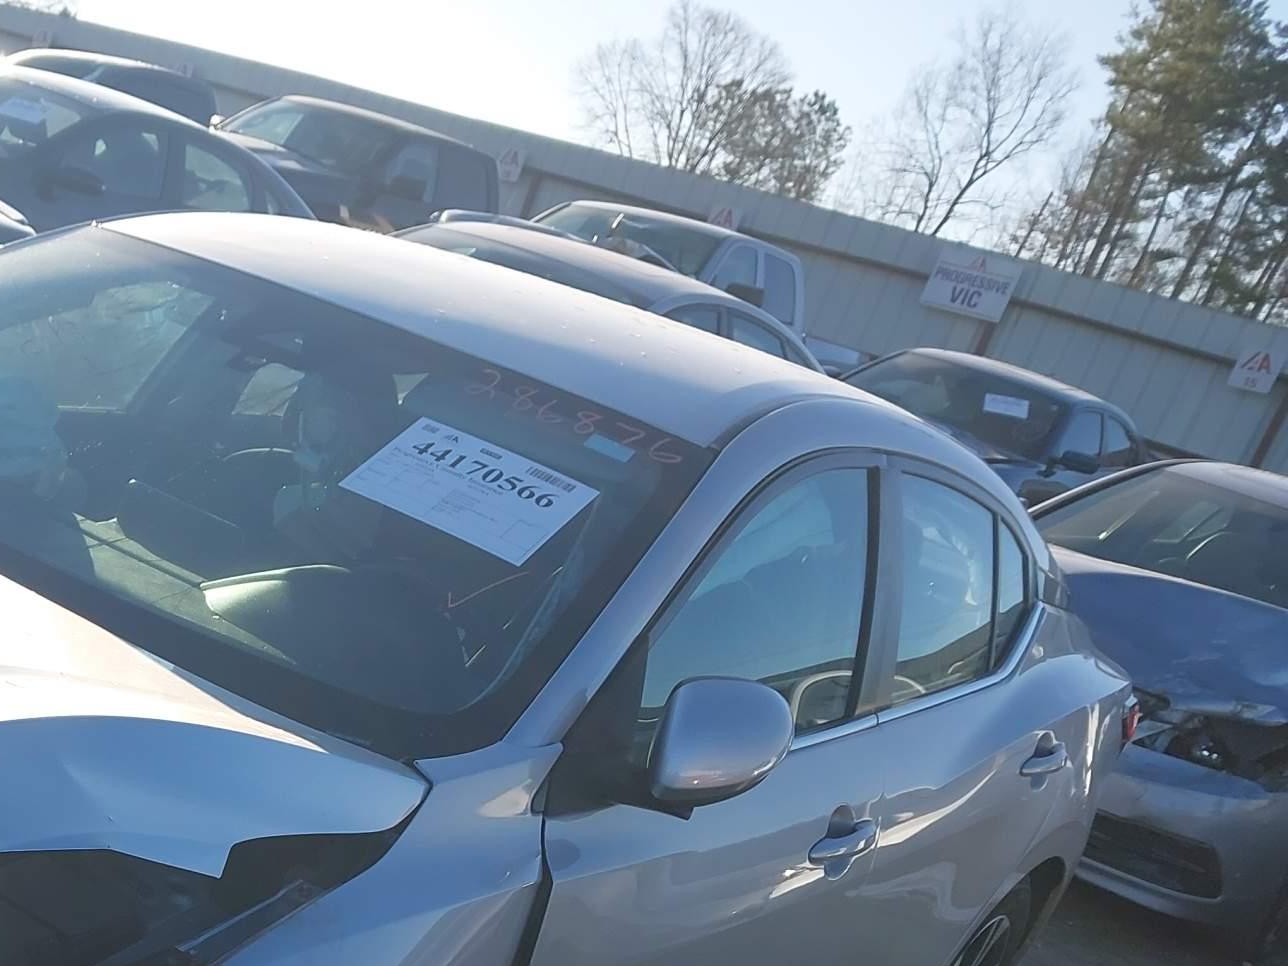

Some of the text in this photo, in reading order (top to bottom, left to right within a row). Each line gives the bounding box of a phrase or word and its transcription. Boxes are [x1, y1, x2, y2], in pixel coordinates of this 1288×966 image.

[934, 265, 1010, 295] PROGRESSIVE
[949, 286, 983, 308] VIC
[465, 368, 683, 464] 286876
[412, 442, 561, 508] 44170566
